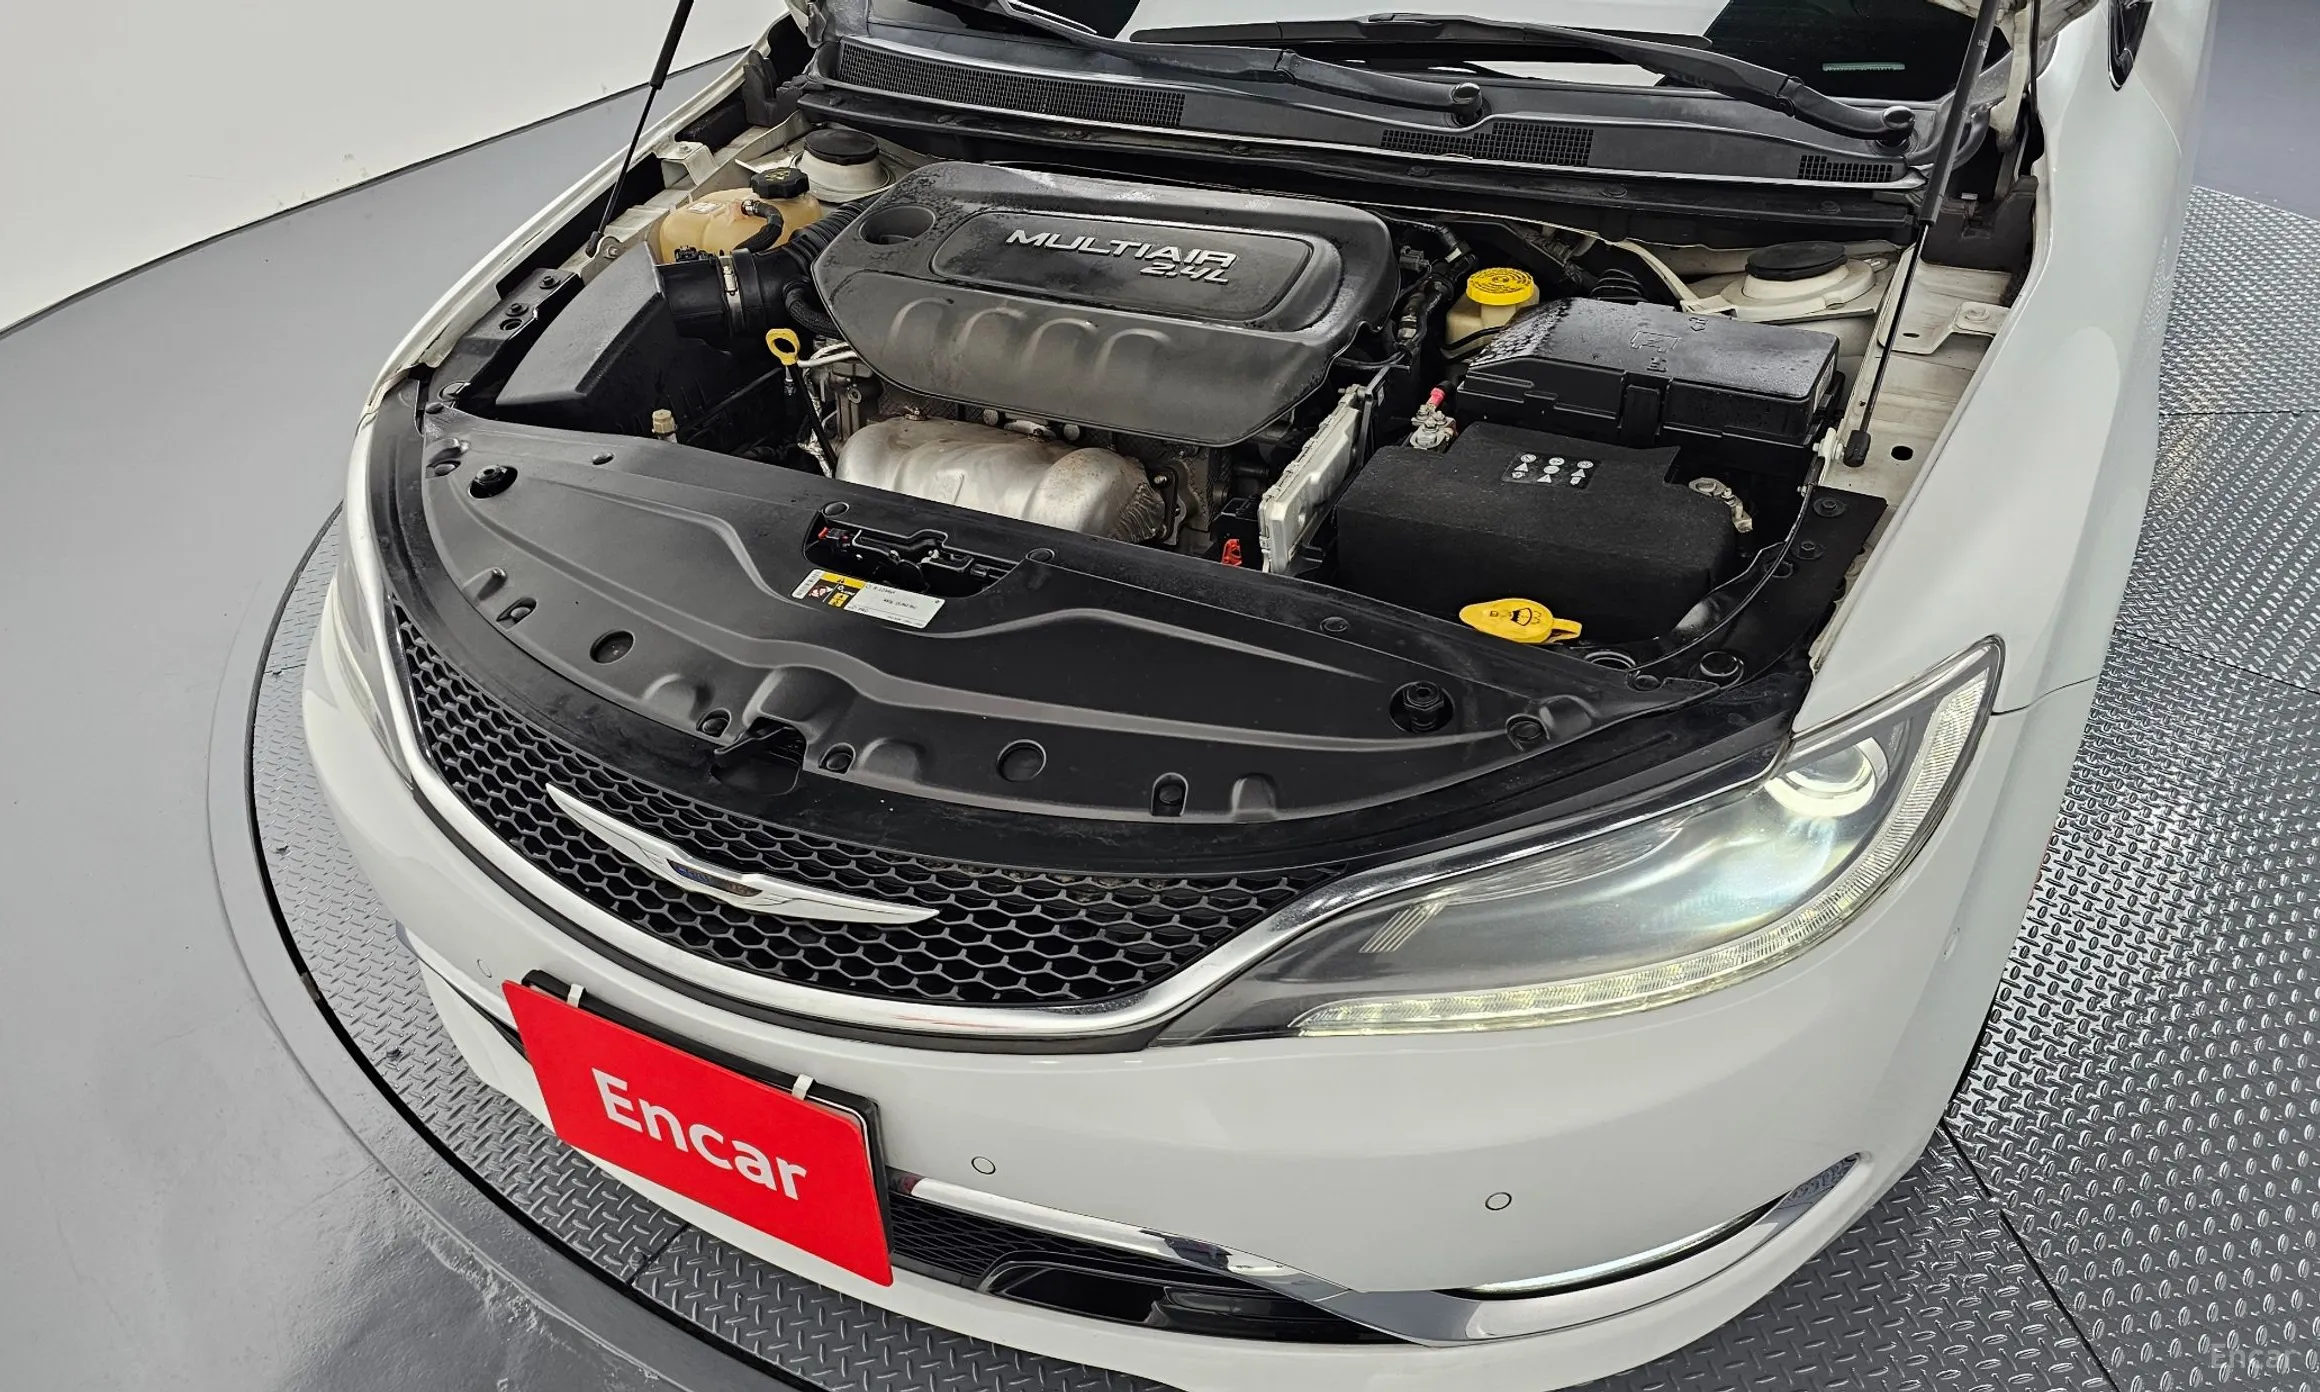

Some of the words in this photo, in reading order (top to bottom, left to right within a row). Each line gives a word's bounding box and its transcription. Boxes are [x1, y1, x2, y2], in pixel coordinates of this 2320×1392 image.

[1005, 229, 1238, 268] MULTIAIR
[1140, 262, 1229, 284] 2.4L
[591, 1067, 807, 1201] Encar
